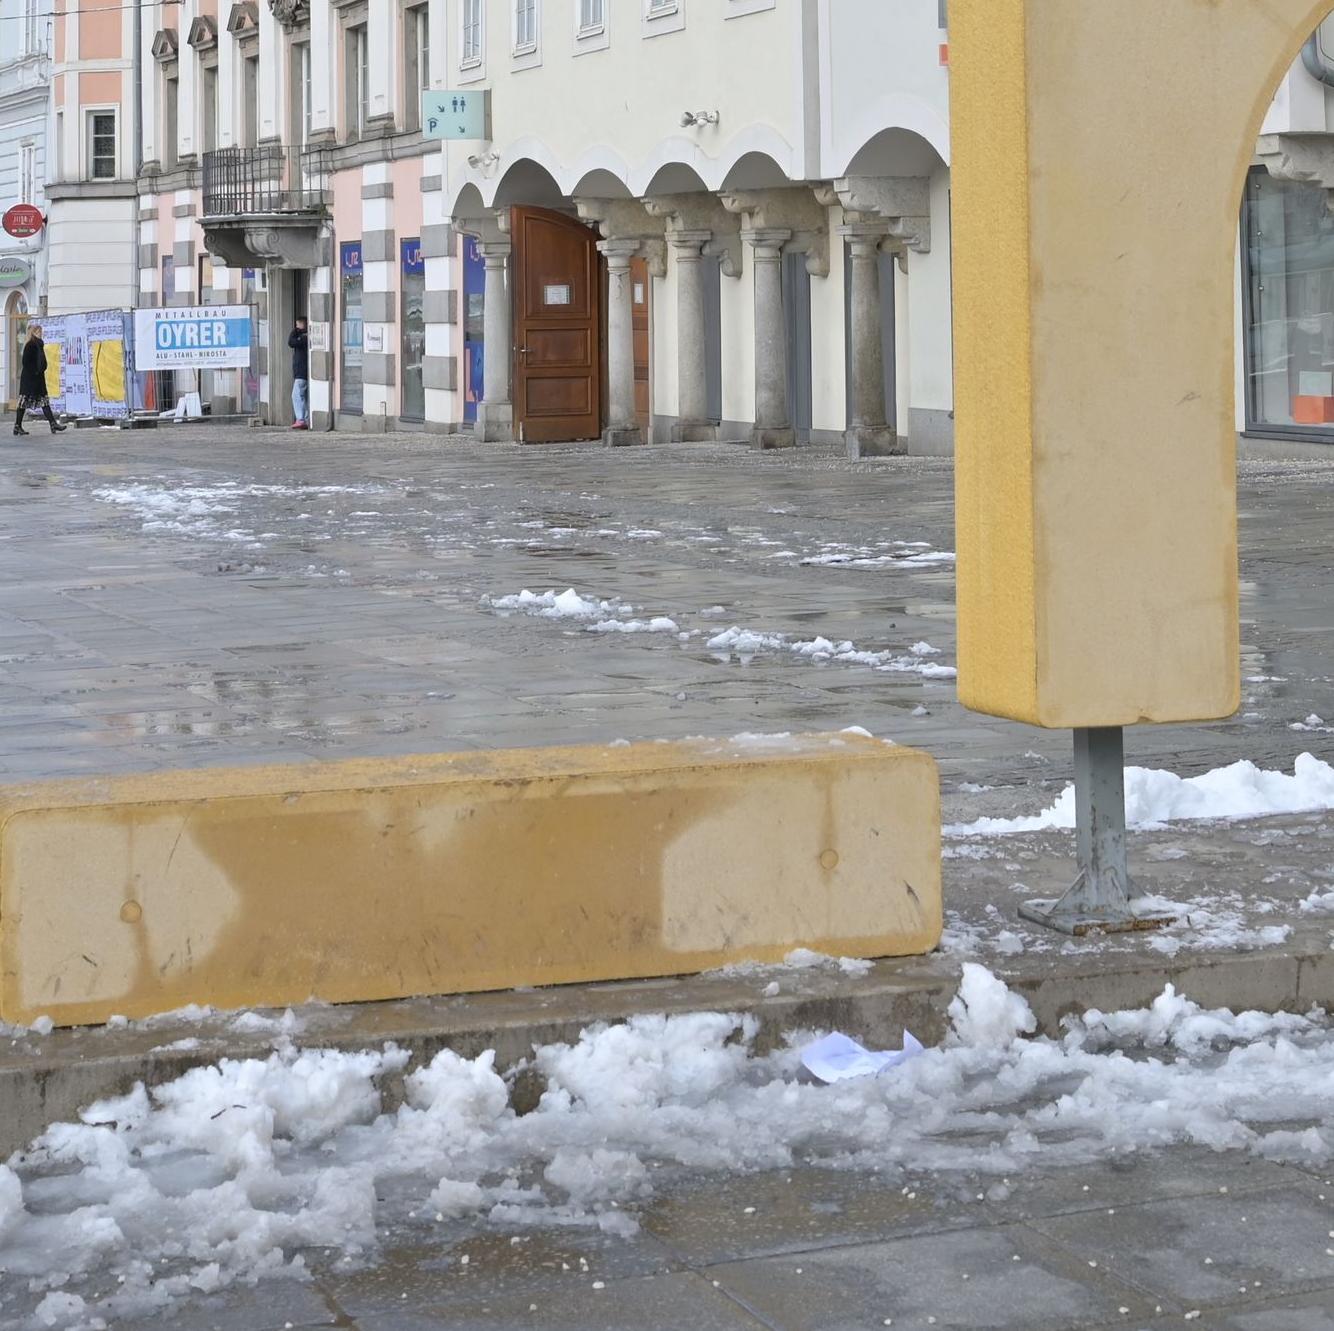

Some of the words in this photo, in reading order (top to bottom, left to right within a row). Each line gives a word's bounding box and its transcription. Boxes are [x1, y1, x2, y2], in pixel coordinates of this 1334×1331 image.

[155, 310, 227, 319] METALLBAU
[158, 322, 227, 348] OYRER
[174, 351, 193, 359] STAHL
